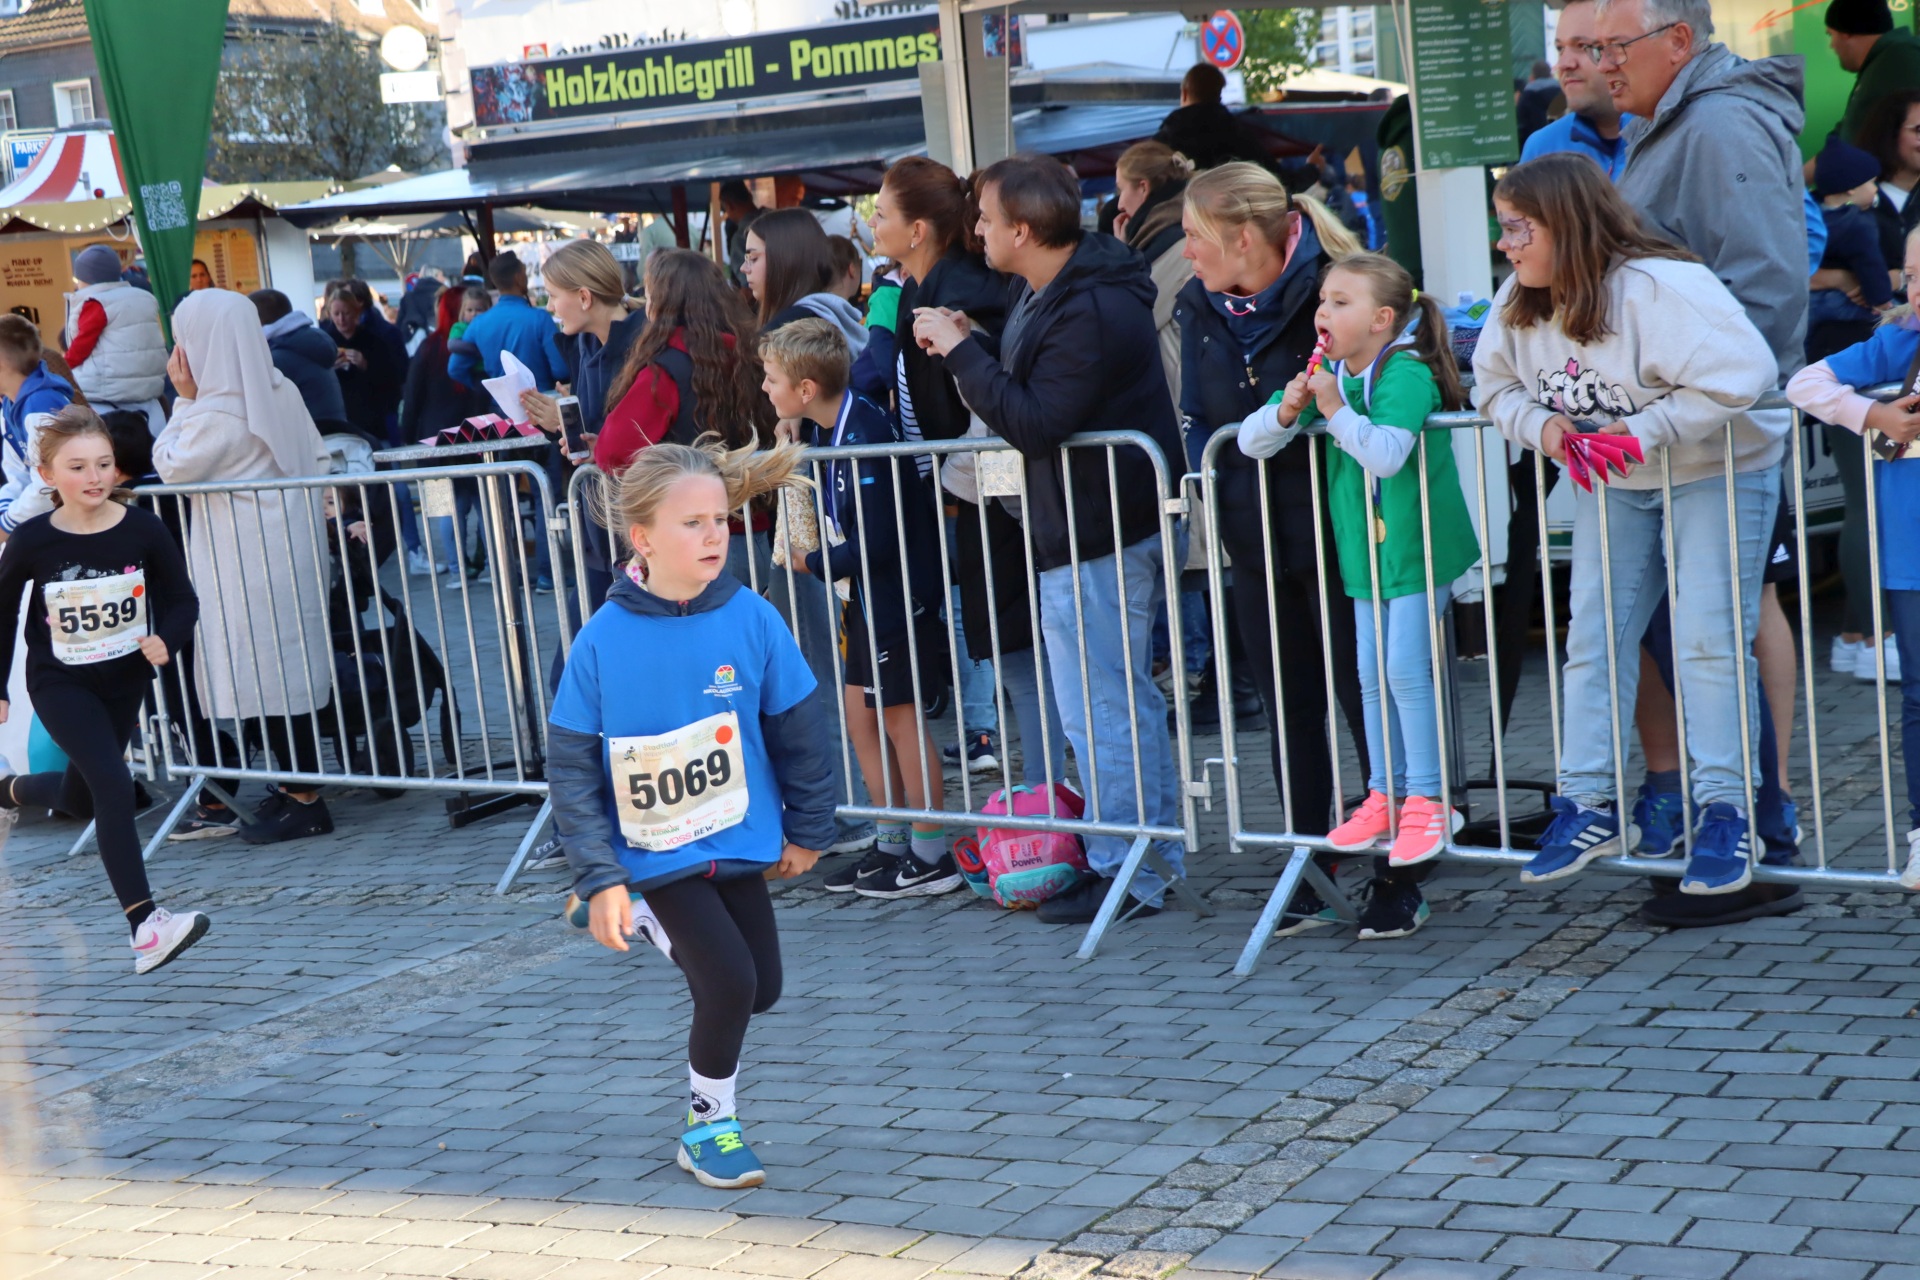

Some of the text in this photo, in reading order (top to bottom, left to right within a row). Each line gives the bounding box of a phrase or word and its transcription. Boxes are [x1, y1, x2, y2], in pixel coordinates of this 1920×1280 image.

[546, 32, 939, 107] Holzkohlegrill - Pommes
[59, 596, 138, 634] 5539
[84, 652, 107, 660] VOSS
[107, 648, 124, 657] BEW
[643, 739, 678, 751] Stadtlauf
[629, 748, 731, 810] 5069
[664, 832, 692, 846] VOSS
[694, 823, 714, 837] BEW
